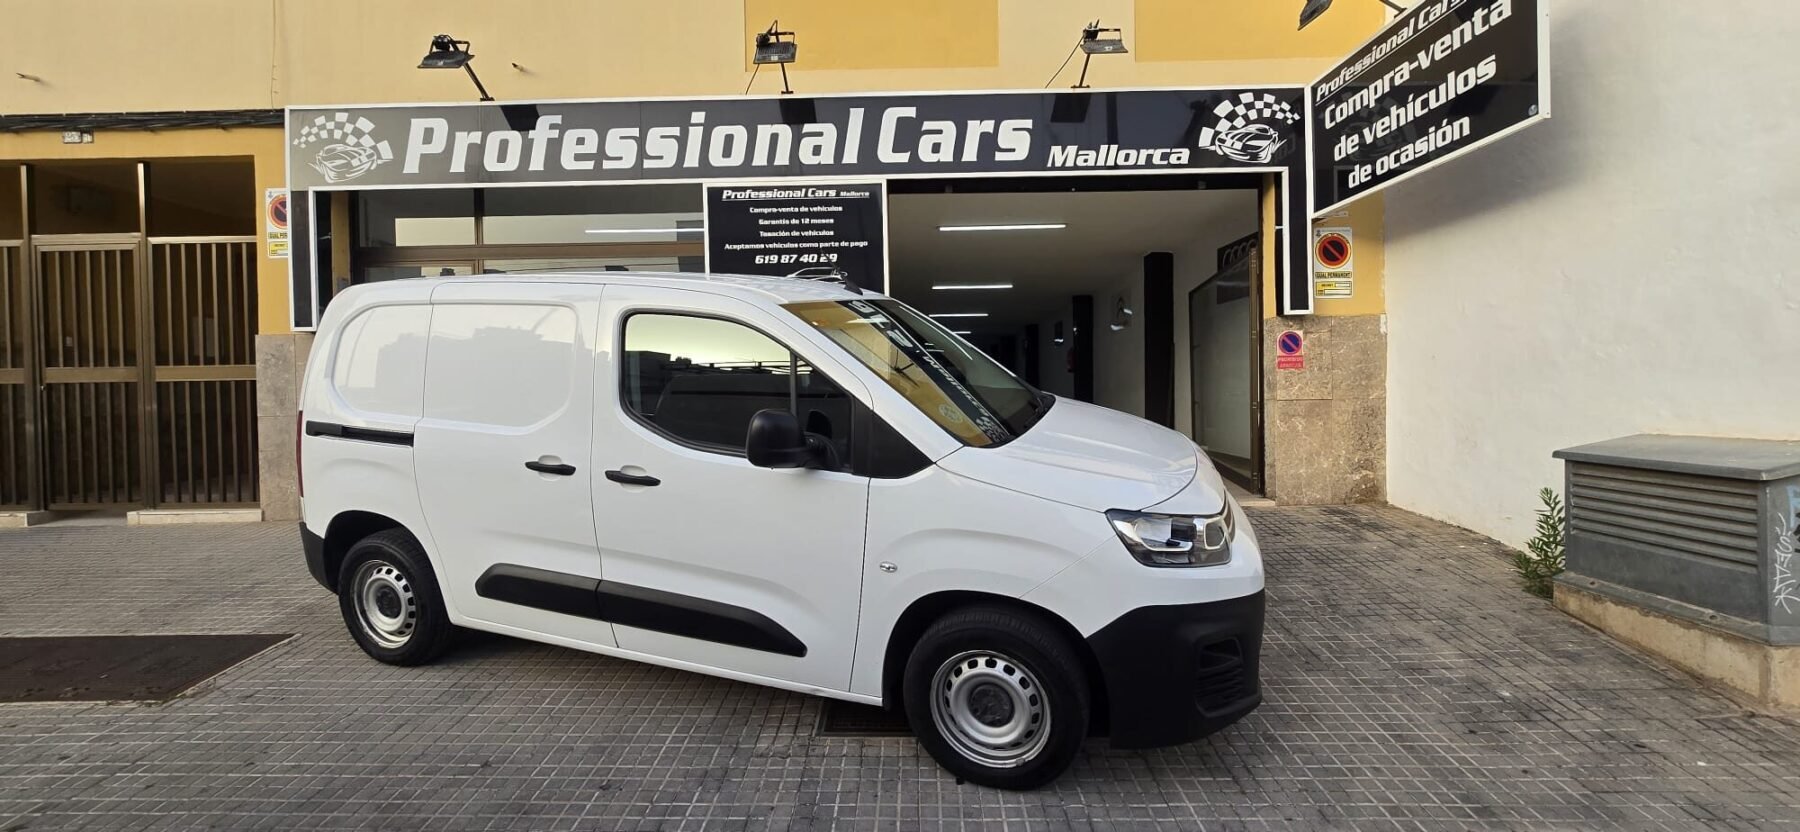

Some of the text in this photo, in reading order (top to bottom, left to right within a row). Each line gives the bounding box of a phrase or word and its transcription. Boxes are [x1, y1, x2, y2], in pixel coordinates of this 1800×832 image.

[1316, 18, 1415, 102] Professional
[1324, 0, 1512, 130] Compra-venta
[402, 106, 1190, 174] Professional Cars Mallorca
[1334, 54, 1497, 162] de vehículos
[1348, 116, 1471, 189] de ocasión
[722, 188, 806, 199] Professional
[807, 188, 837, 197] Cars
[749, 206, 799, 214] Compra-venta
[724, 243, 765, 251] Aceptamos
[754, 254, 778, 264] 619
[780, 254, 798, 264] 87
[799, 253, 818, 263] 40
